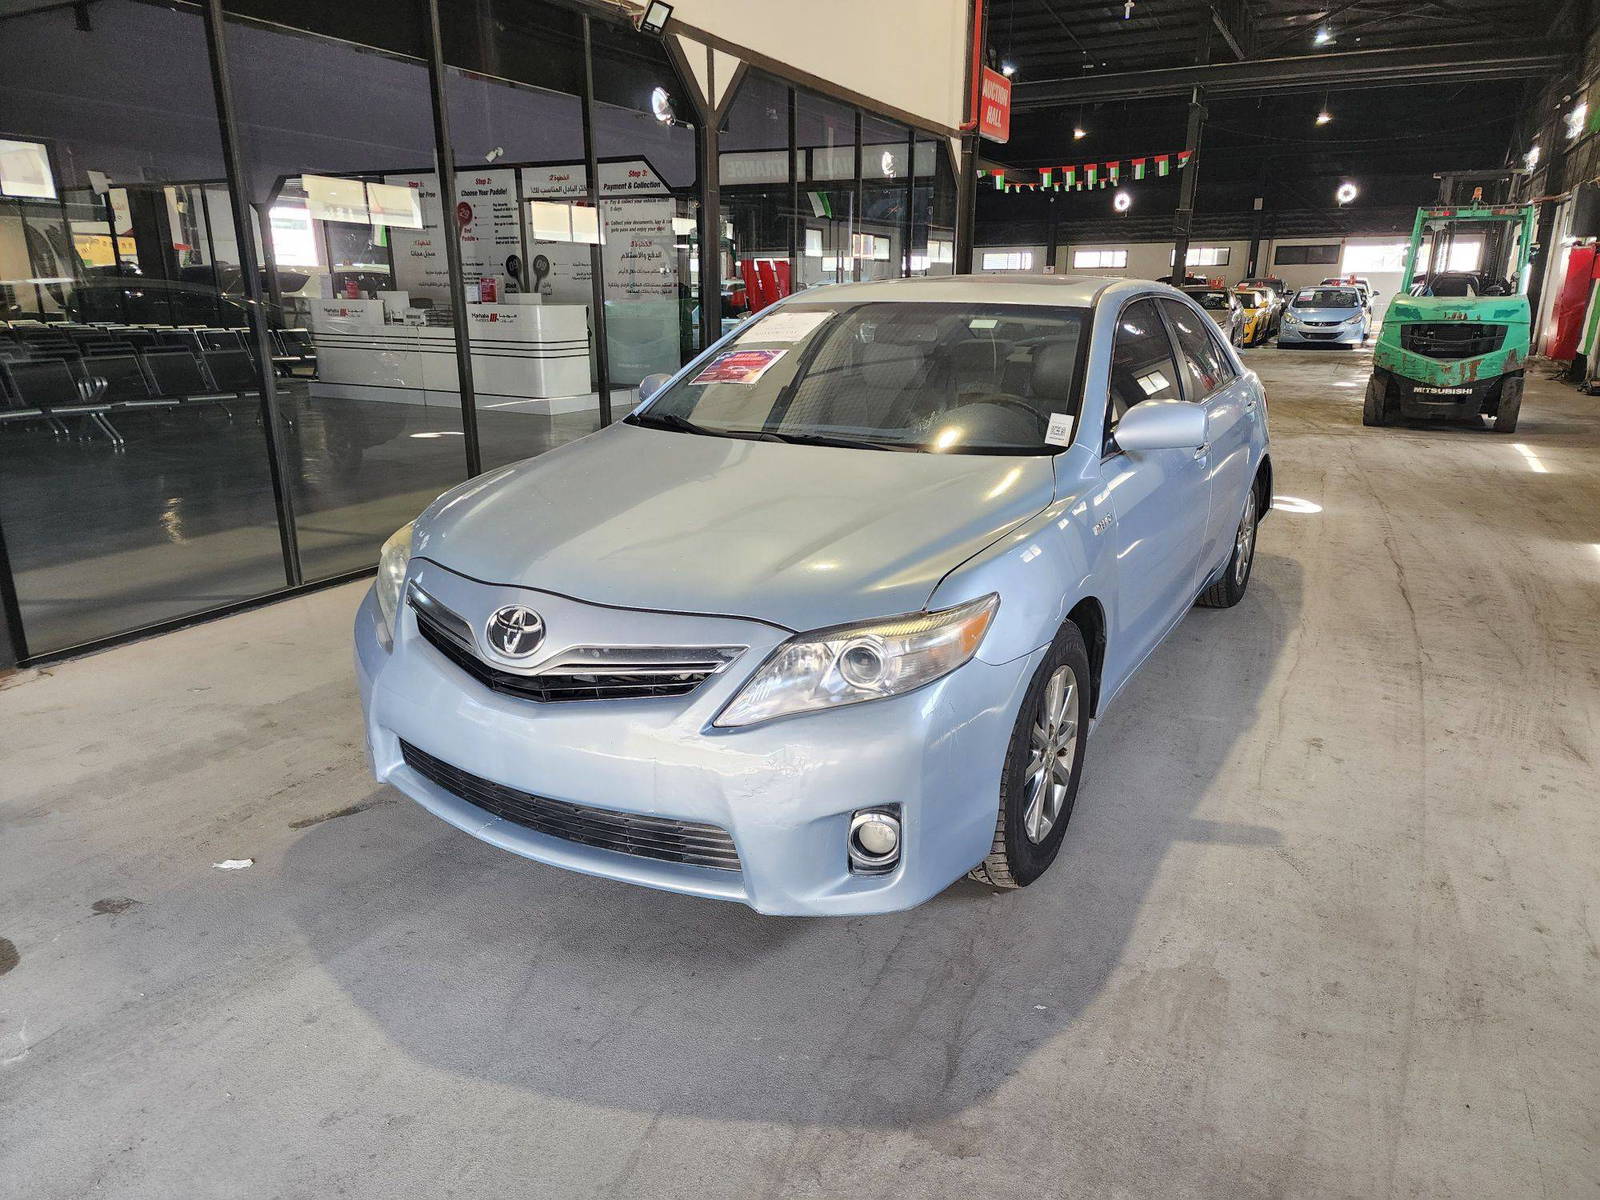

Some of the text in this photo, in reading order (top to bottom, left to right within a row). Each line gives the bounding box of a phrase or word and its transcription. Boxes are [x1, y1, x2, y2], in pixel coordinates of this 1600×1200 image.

[983, 79, 1008, 106] AUCTION
[986, 105, 1001, 128] HALL
[628, 170, 640, 178] Step
[603, 182, 627, 192] Payment
[633, 181, 661, 189] Collection
[1413, 386, 1473, 395] MITSUBISHI
